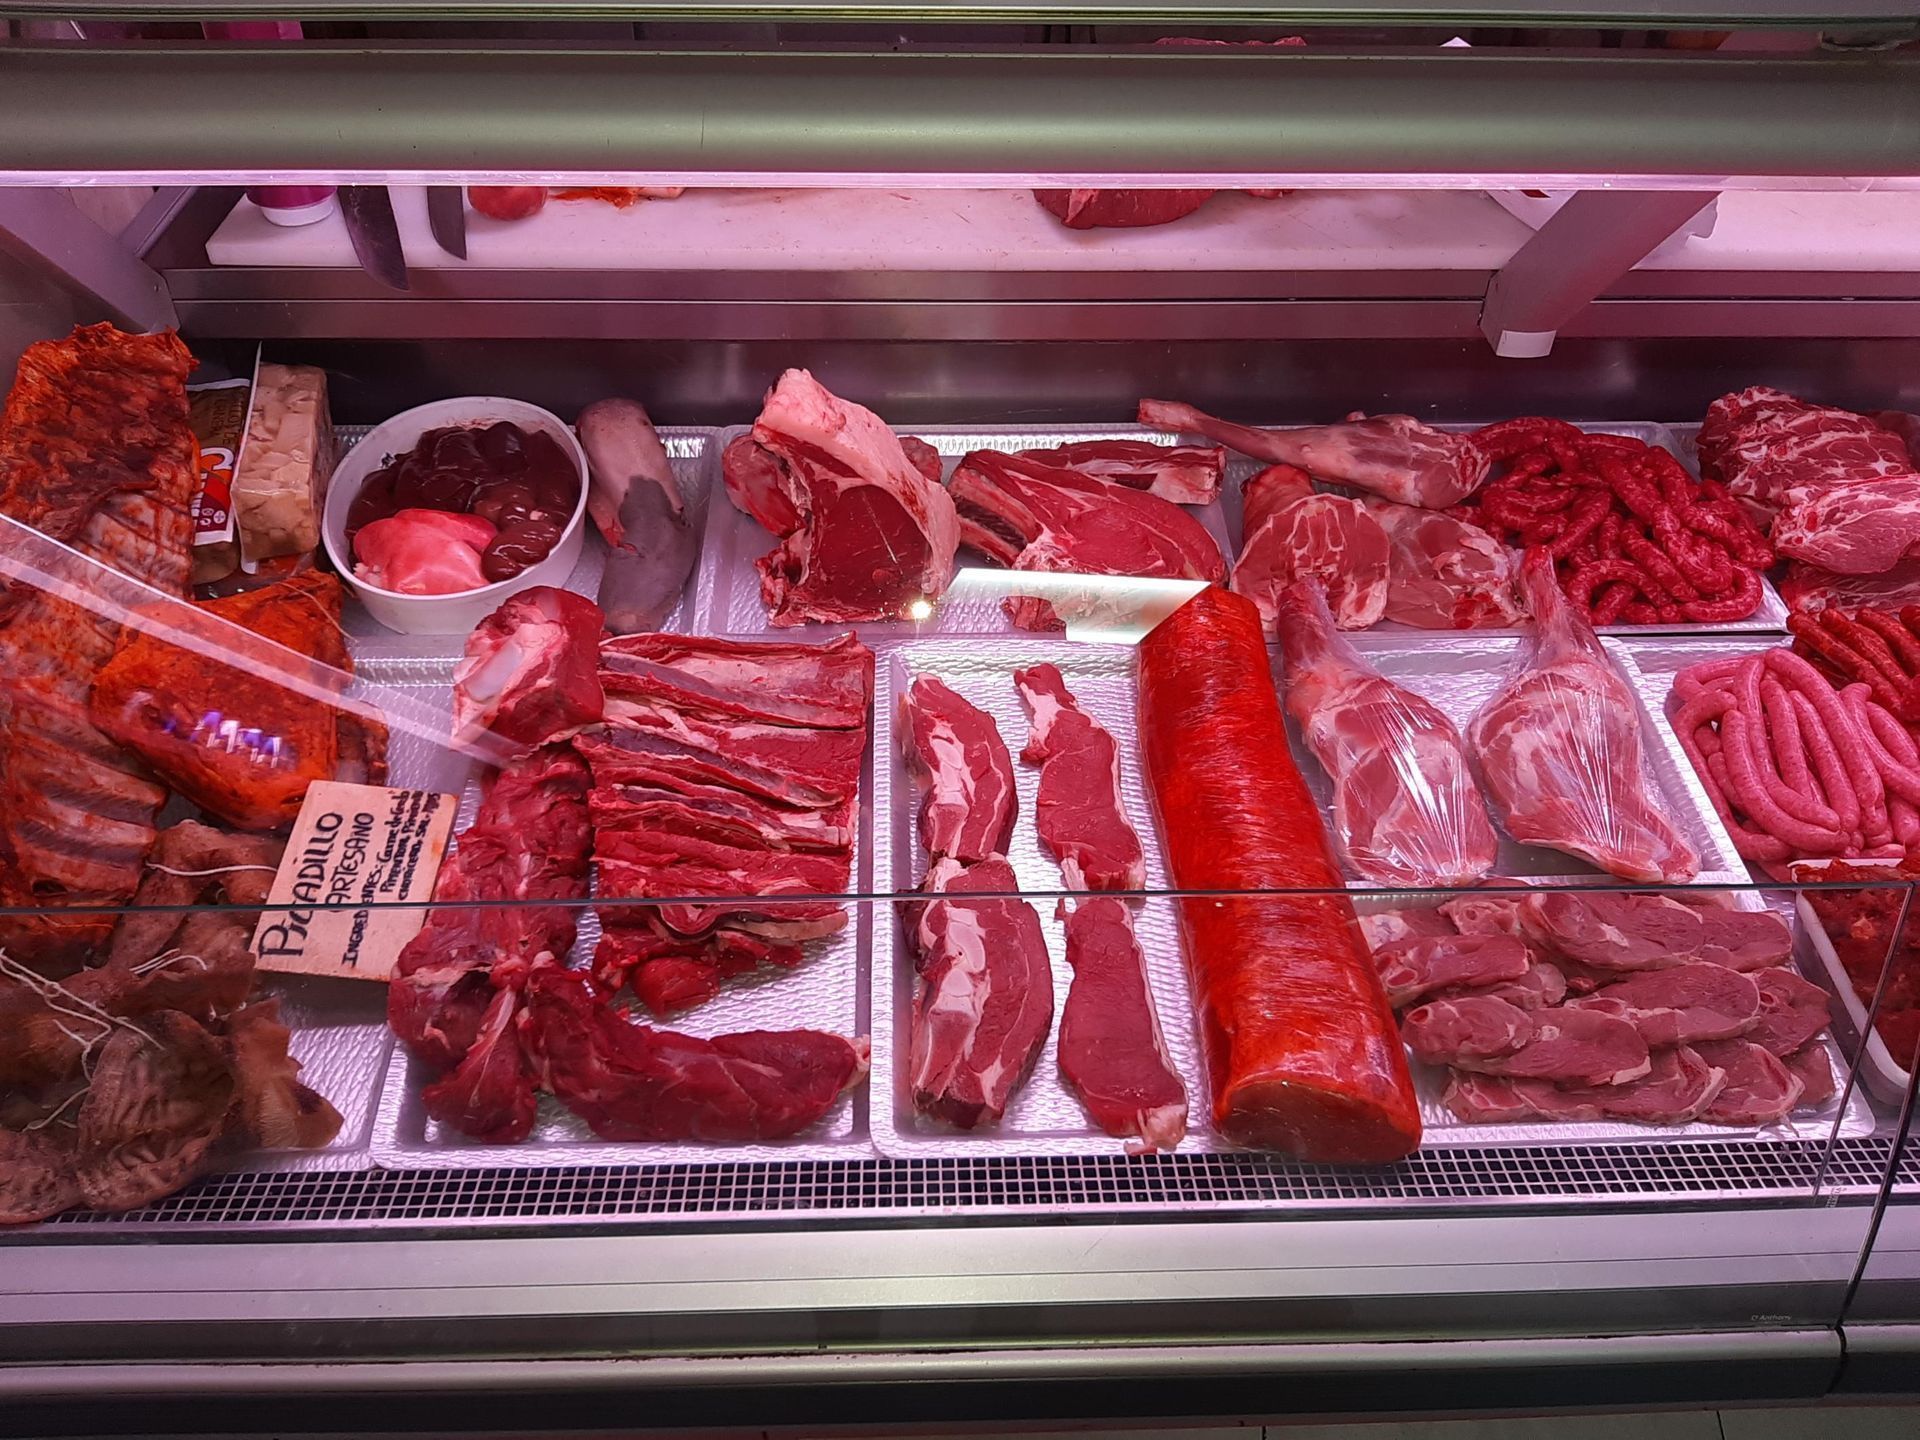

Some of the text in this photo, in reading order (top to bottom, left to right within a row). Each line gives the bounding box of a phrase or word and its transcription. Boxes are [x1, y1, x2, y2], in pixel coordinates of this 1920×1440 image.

[325, 812, 375, 913] ARTESANO
[342, 865, 384, 968] INGREDENTES:
[377, 828, 399, 864] Carne
